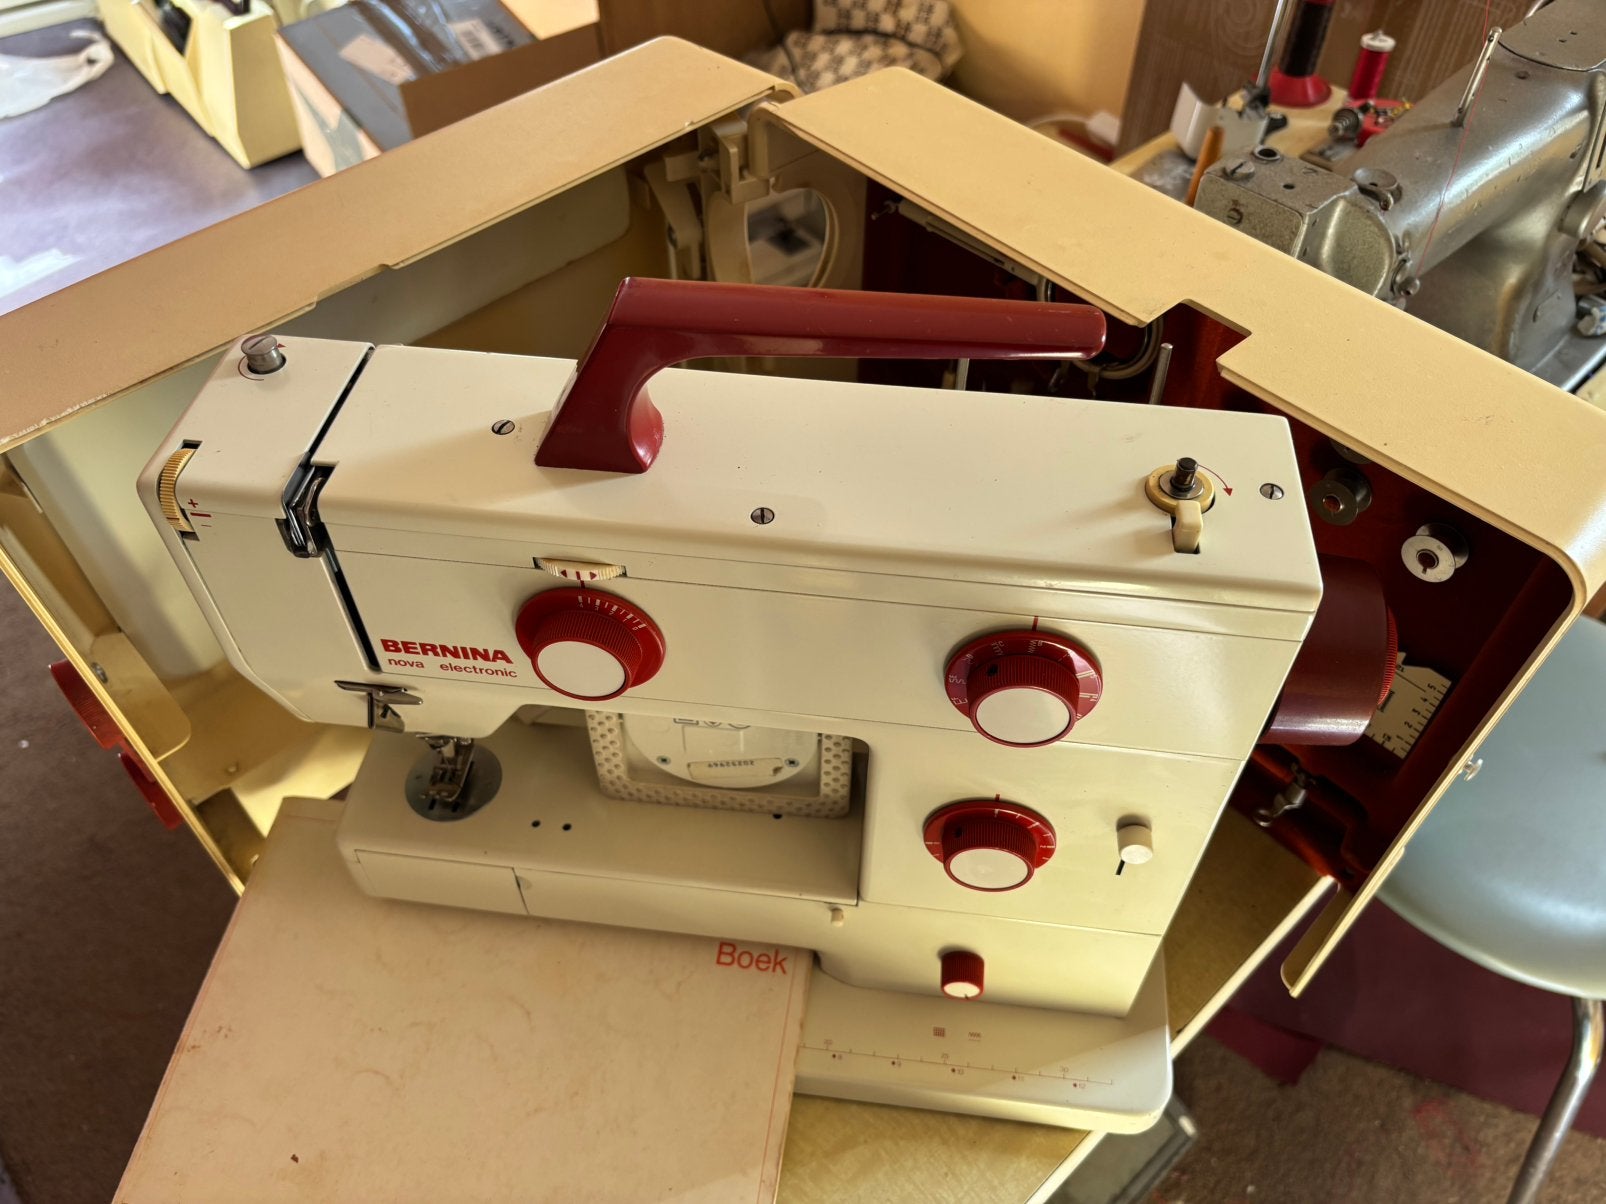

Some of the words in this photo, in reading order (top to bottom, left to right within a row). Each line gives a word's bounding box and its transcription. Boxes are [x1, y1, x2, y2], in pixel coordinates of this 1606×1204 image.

[380, 639, 513, 664] BERNINA
[388, 658, 425, 669] nova
[439, 663, 518, 678] electronic
[716, 941, 788, 975] Boek
